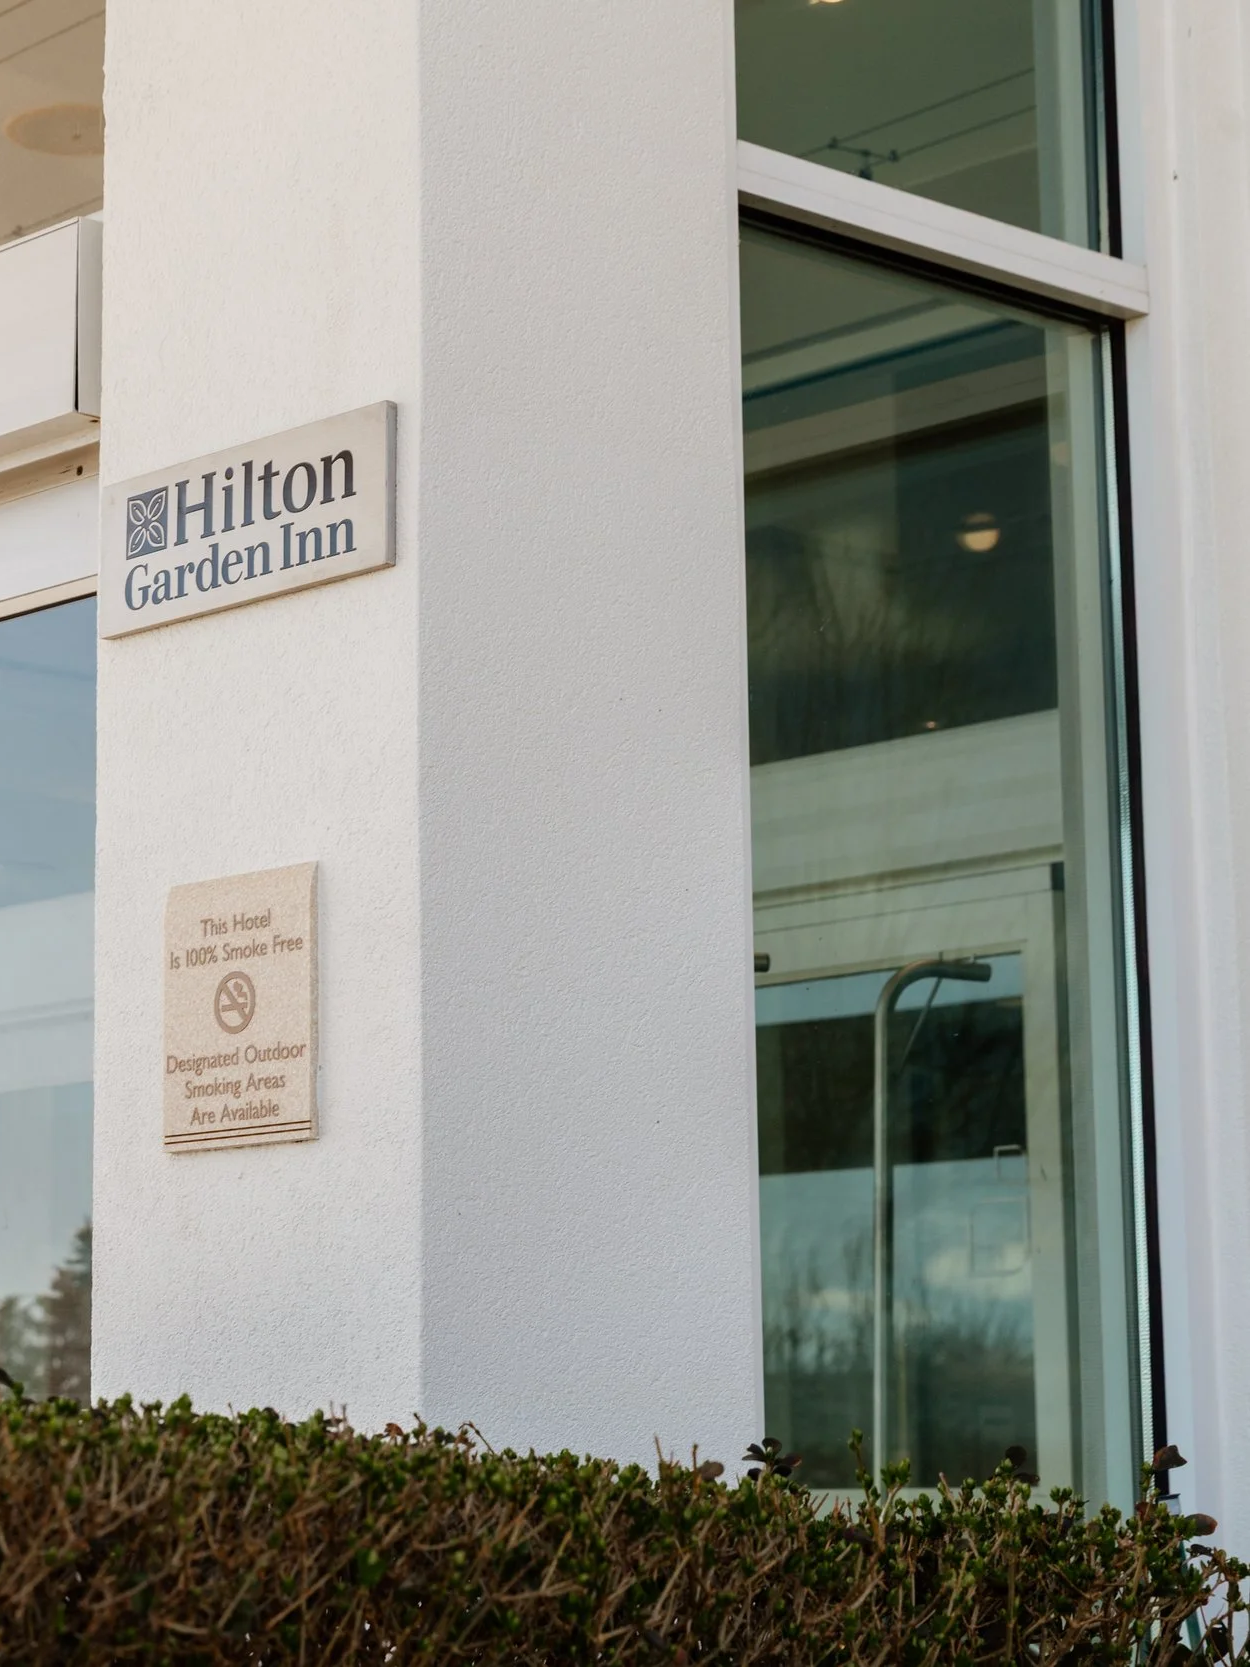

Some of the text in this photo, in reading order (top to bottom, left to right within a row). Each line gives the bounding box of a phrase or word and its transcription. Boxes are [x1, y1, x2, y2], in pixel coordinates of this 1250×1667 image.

[174, 450, 357, 546] Hilton
[125, 518, 357, 611] Garden Inn
[200, 908, 271, 937] This Hotel
[170, 934, 303, 969] Is 100% Smoke Free
[166, 1042, 306, 1076] Designated Outdoor
[185, 1072, 286, 1098] Smoking Areas
[190, 1099, 280, 1126] Are Available
